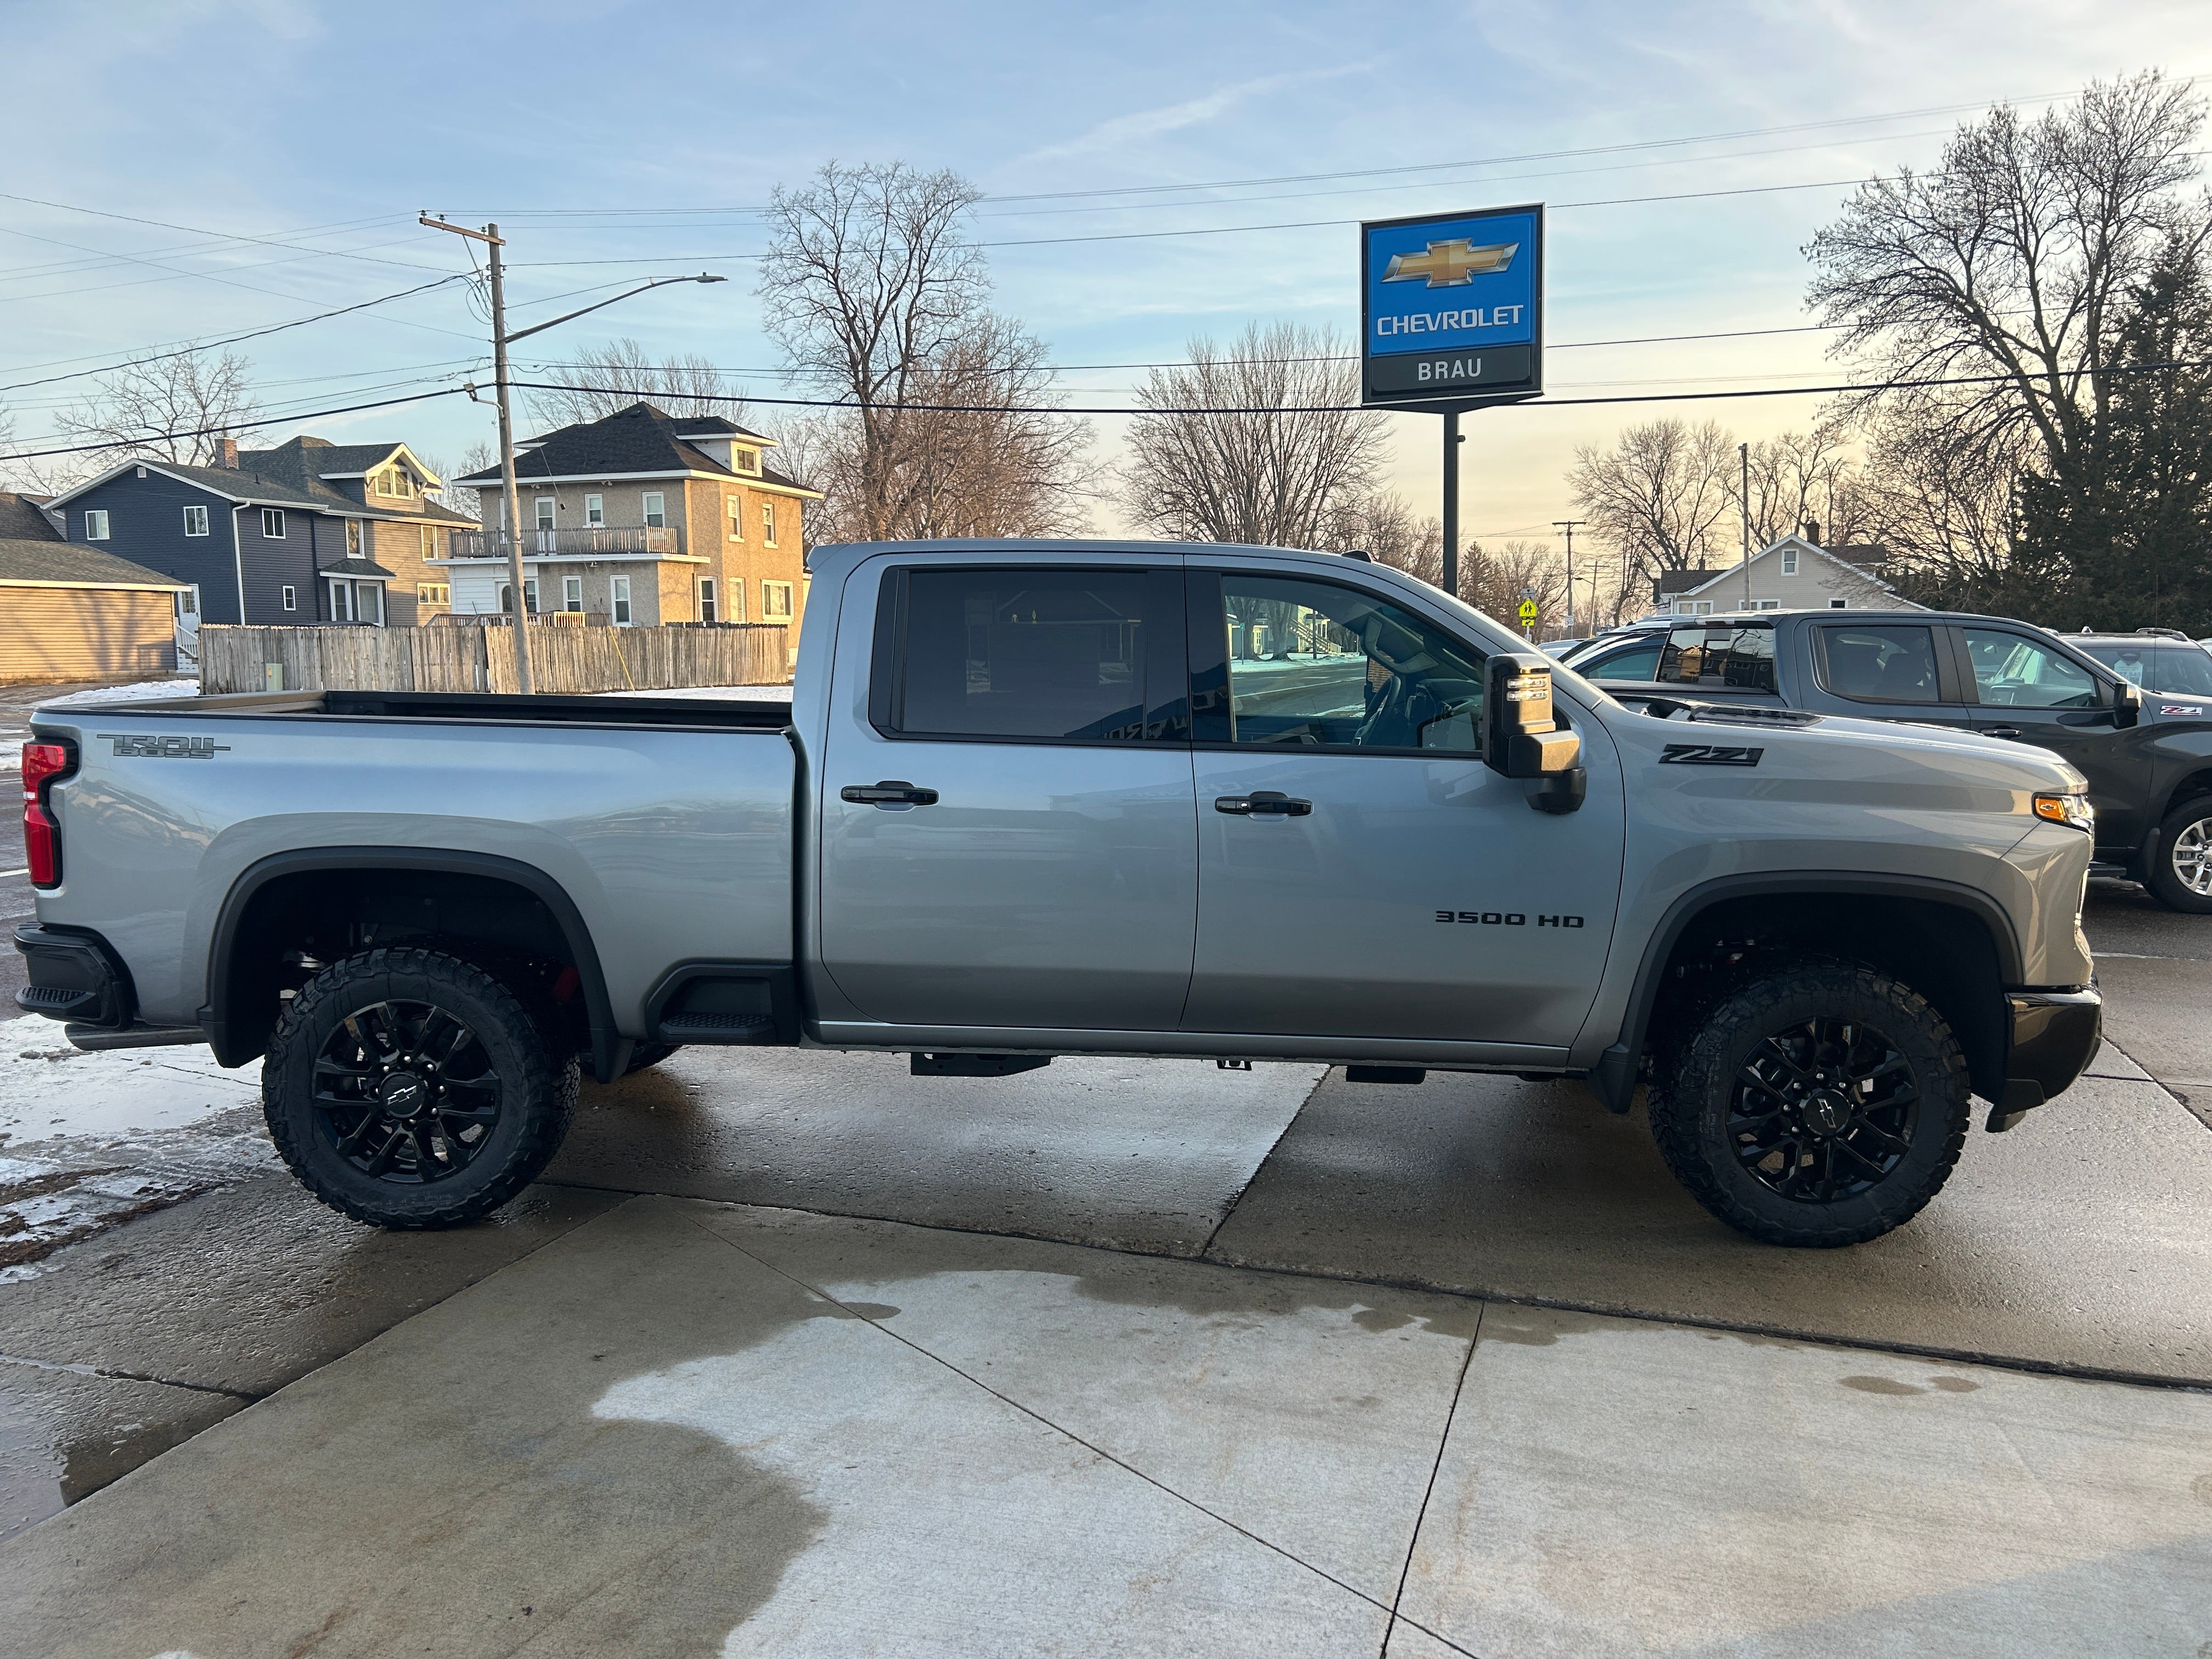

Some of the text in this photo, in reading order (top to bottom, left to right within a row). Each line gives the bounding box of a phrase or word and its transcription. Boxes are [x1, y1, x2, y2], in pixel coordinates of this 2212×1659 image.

[1377, 304, 1524, 336] CHEVROLET
[1418, 357, 1482, 381] BRAU
[2160, 705, 2203, 715] Z71
[97, 734, 230, 751] TRAIL
[114, 746, 214, 759] BOSS
[1658, 744, 1764, 766] Z71
[1435, 910, 1584, 928] 3500 HD
